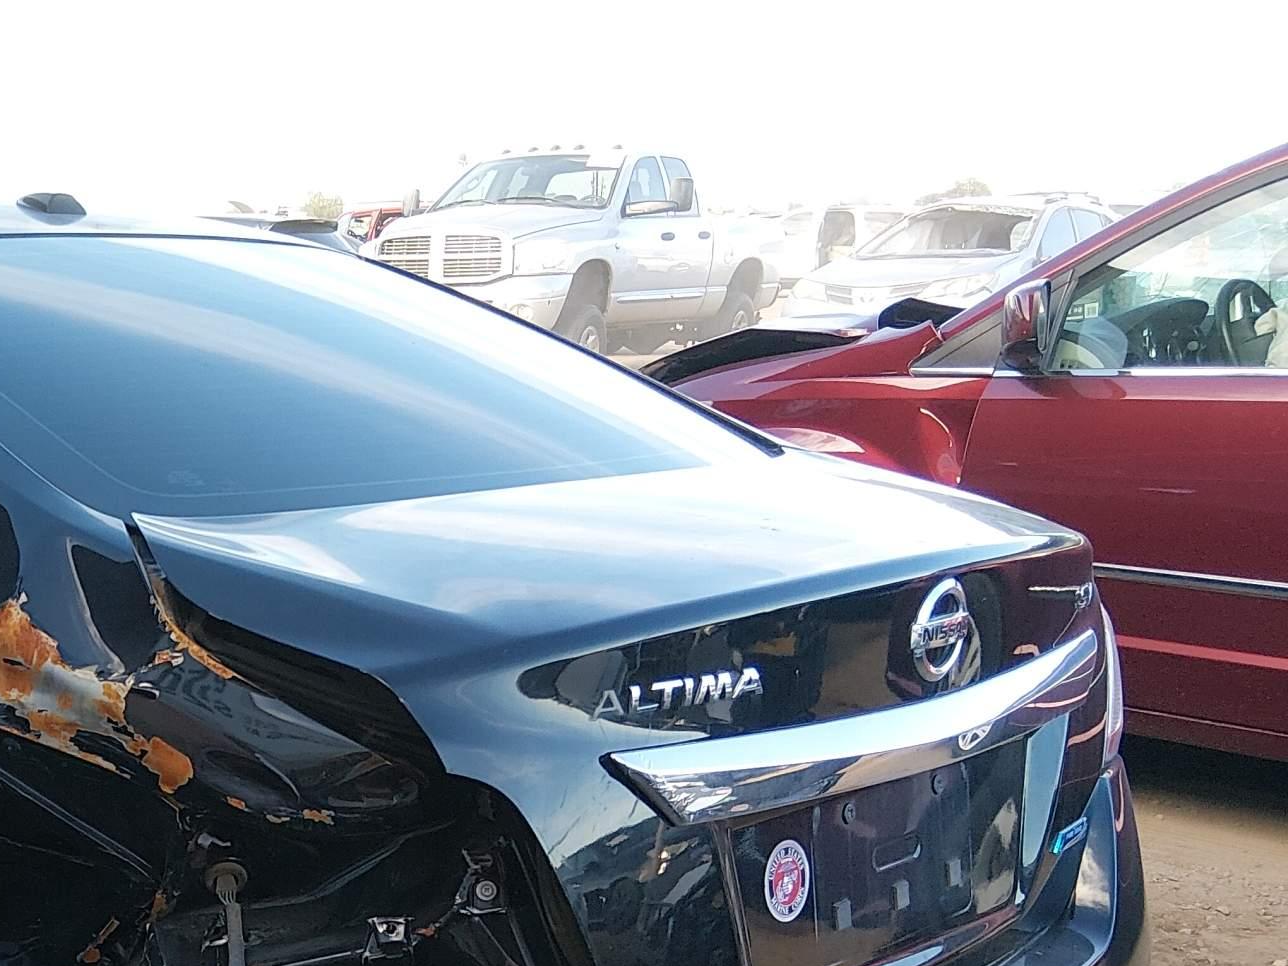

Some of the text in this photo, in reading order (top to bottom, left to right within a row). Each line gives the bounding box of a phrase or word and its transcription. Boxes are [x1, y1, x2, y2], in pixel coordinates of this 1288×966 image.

[590, 667, 764, 721] ALTIMA
[768, 847, 804, 880] UNITED STATES
